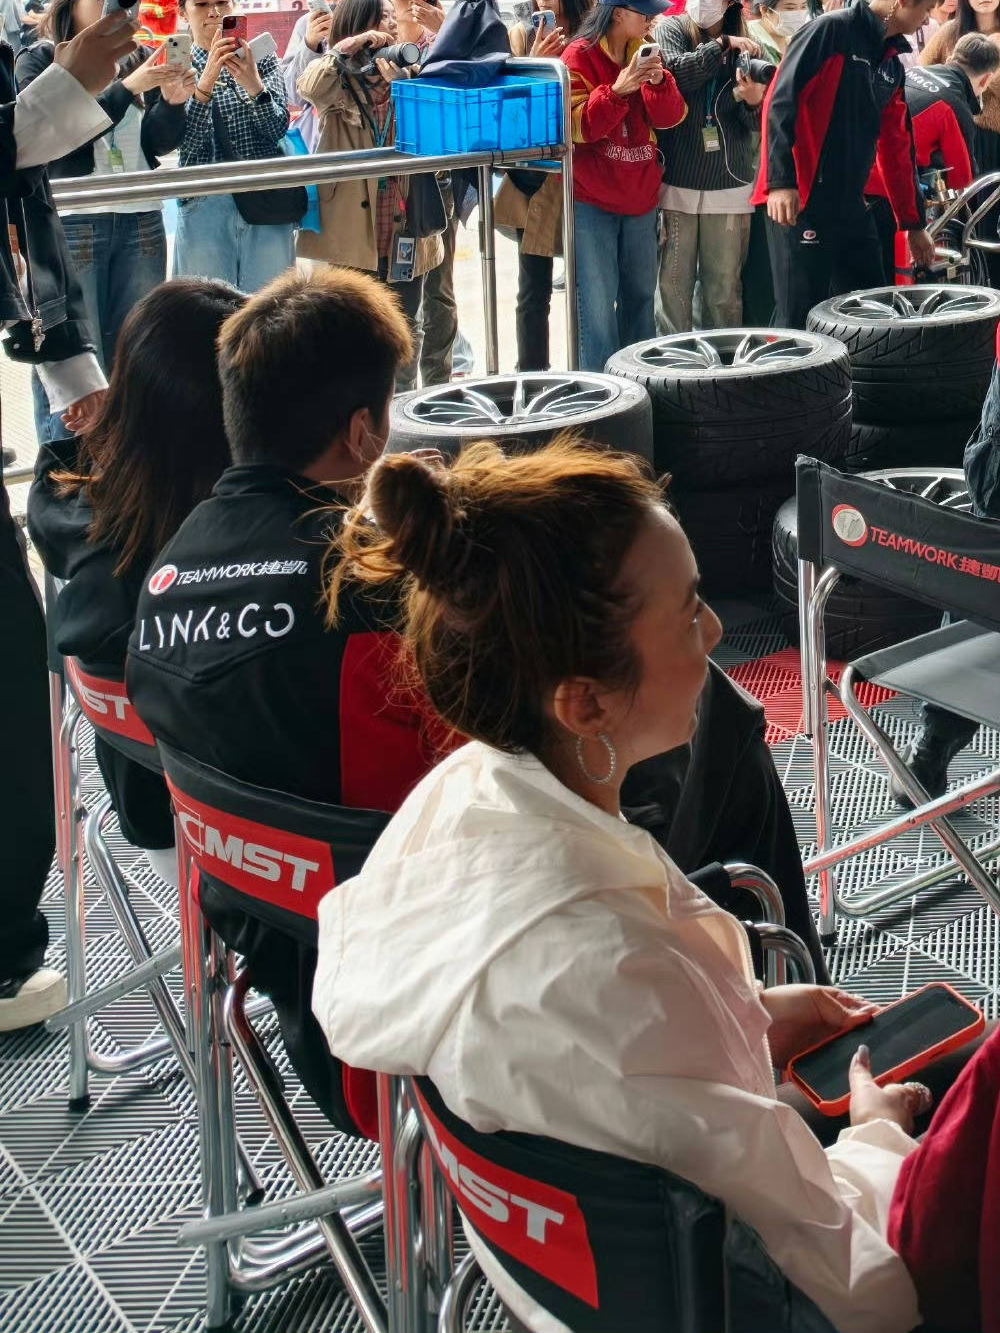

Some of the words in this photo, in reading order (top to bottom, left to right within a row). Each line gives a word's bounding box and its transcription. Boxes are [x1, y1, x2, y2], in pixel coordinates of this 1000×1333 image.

[870, 526, 958, 570] TEAMWORK
[176, 562, 262, 586] TEAMWORK
[178, 811, 319, 892] CMST
